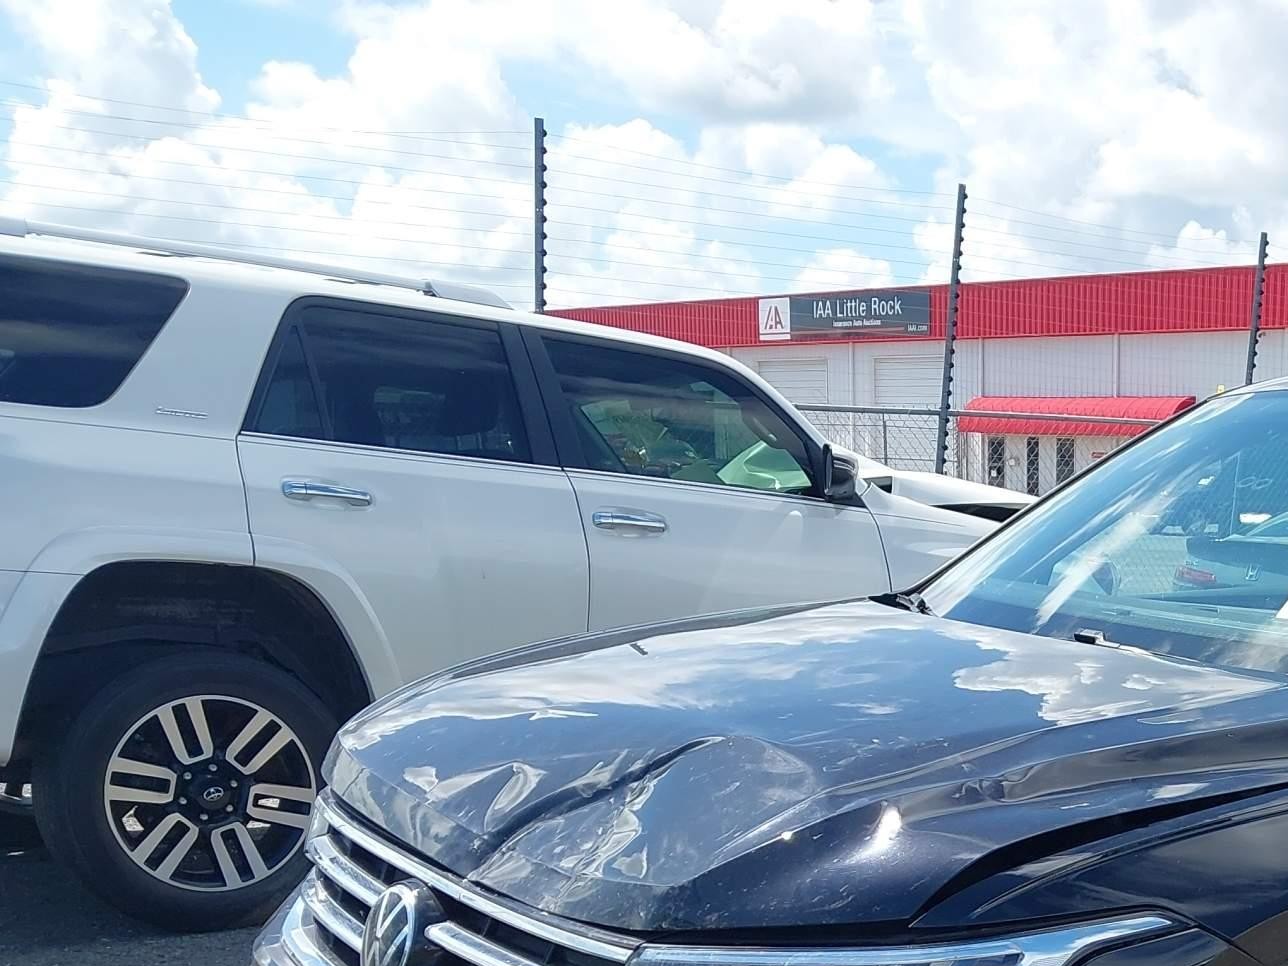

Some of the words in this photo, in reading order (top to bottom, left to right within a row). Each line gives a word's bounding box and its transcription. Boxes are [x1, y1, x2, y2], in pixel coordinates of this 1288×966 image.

[813, 300, 833, 319] IAA
[836, 298, 867, 318] Little
[871, 295, 902, 316] Rock
